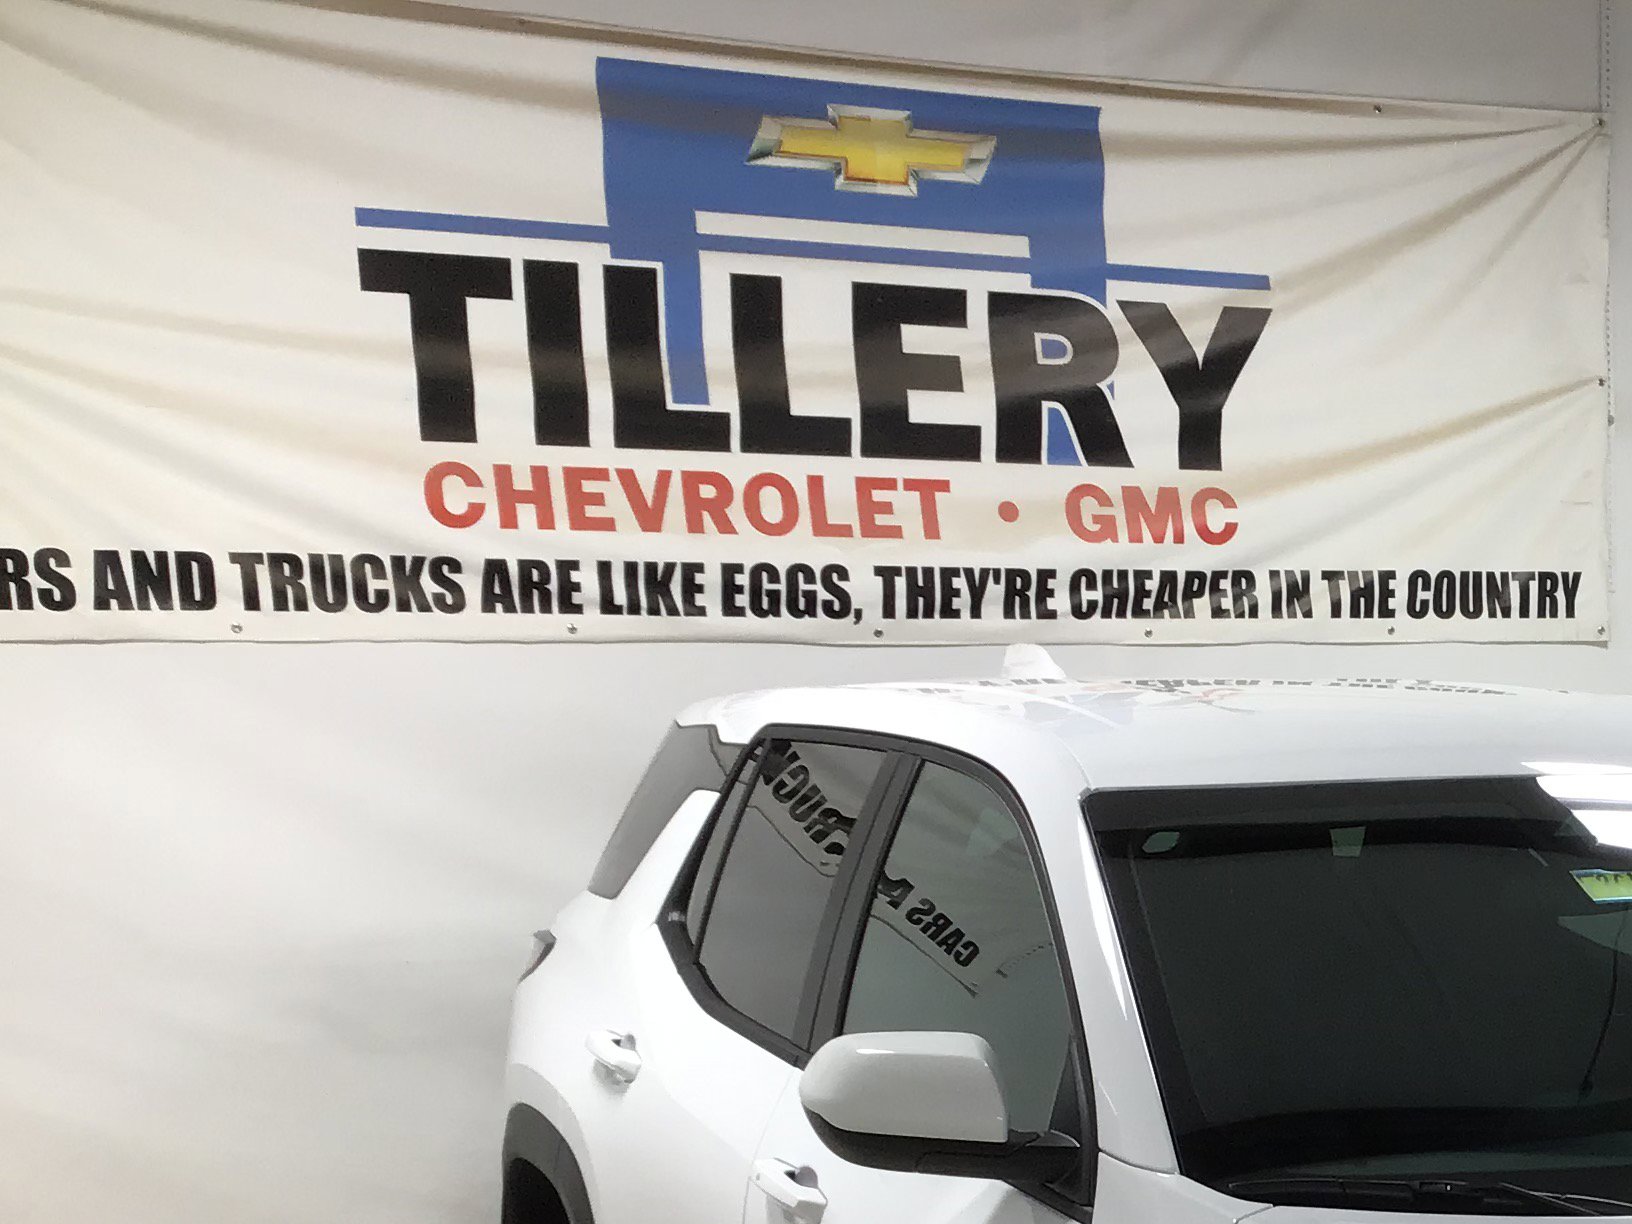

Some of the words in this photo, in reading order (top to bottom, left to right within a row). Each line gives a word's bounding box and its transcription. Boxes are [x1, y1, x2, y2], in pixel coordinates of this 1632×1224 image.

[357, 247, 1272, 471] TILLERY
[423, 461, 951, 541] CHEVROLET
[1064, 483, 1239, 547] GMC
[93, 549, 217, 611] AND
[228, 552, 466, 614] TRUCKS
[481, 558, 584, 615] ARE
[597, 560, 707, 617] LIKE
[721, 562, 863, 625] EGGS,
[873, 565, 1058, 620] THEY'RE
[1068, 568, 1259, 620] CHEAPER
[1268, 569, 1313, 619] IN
[1321, 570, 1397, 619] THE
[1406, 569, 1581, 620] COUNTRY
